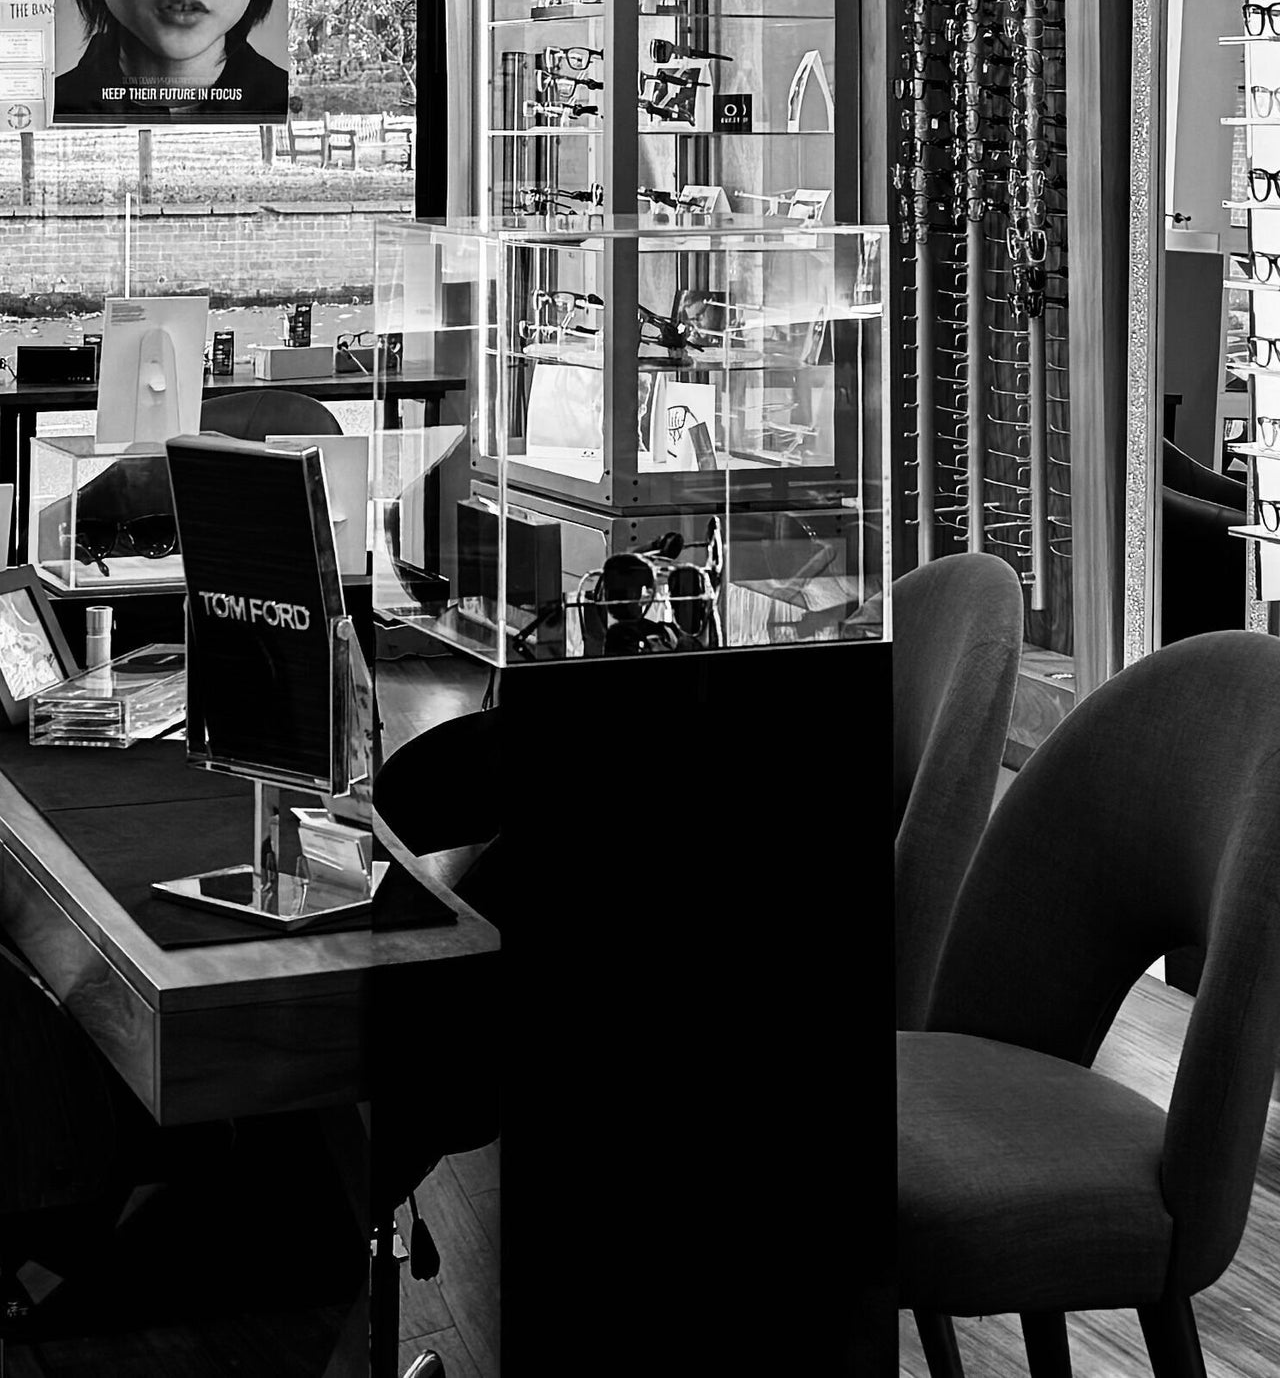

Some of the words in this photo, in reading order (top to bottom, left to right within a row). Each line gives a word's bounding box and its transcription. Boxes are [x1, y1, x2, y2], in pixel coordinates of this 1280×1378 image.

[10, 2, 29, 19] THE
[31, 3, 52, 16] BAN
[102, 87, 127, 100] KEEP
[129, 87, 157, 100] THEIR
[159, 87, 196, 100] FUTURE
[198, 87, 209, 100] IN
[210, 87, 243, 101] FOCUS
[199, 591, 247, 621] TOM
[249, 598, 310, 631] FORD
